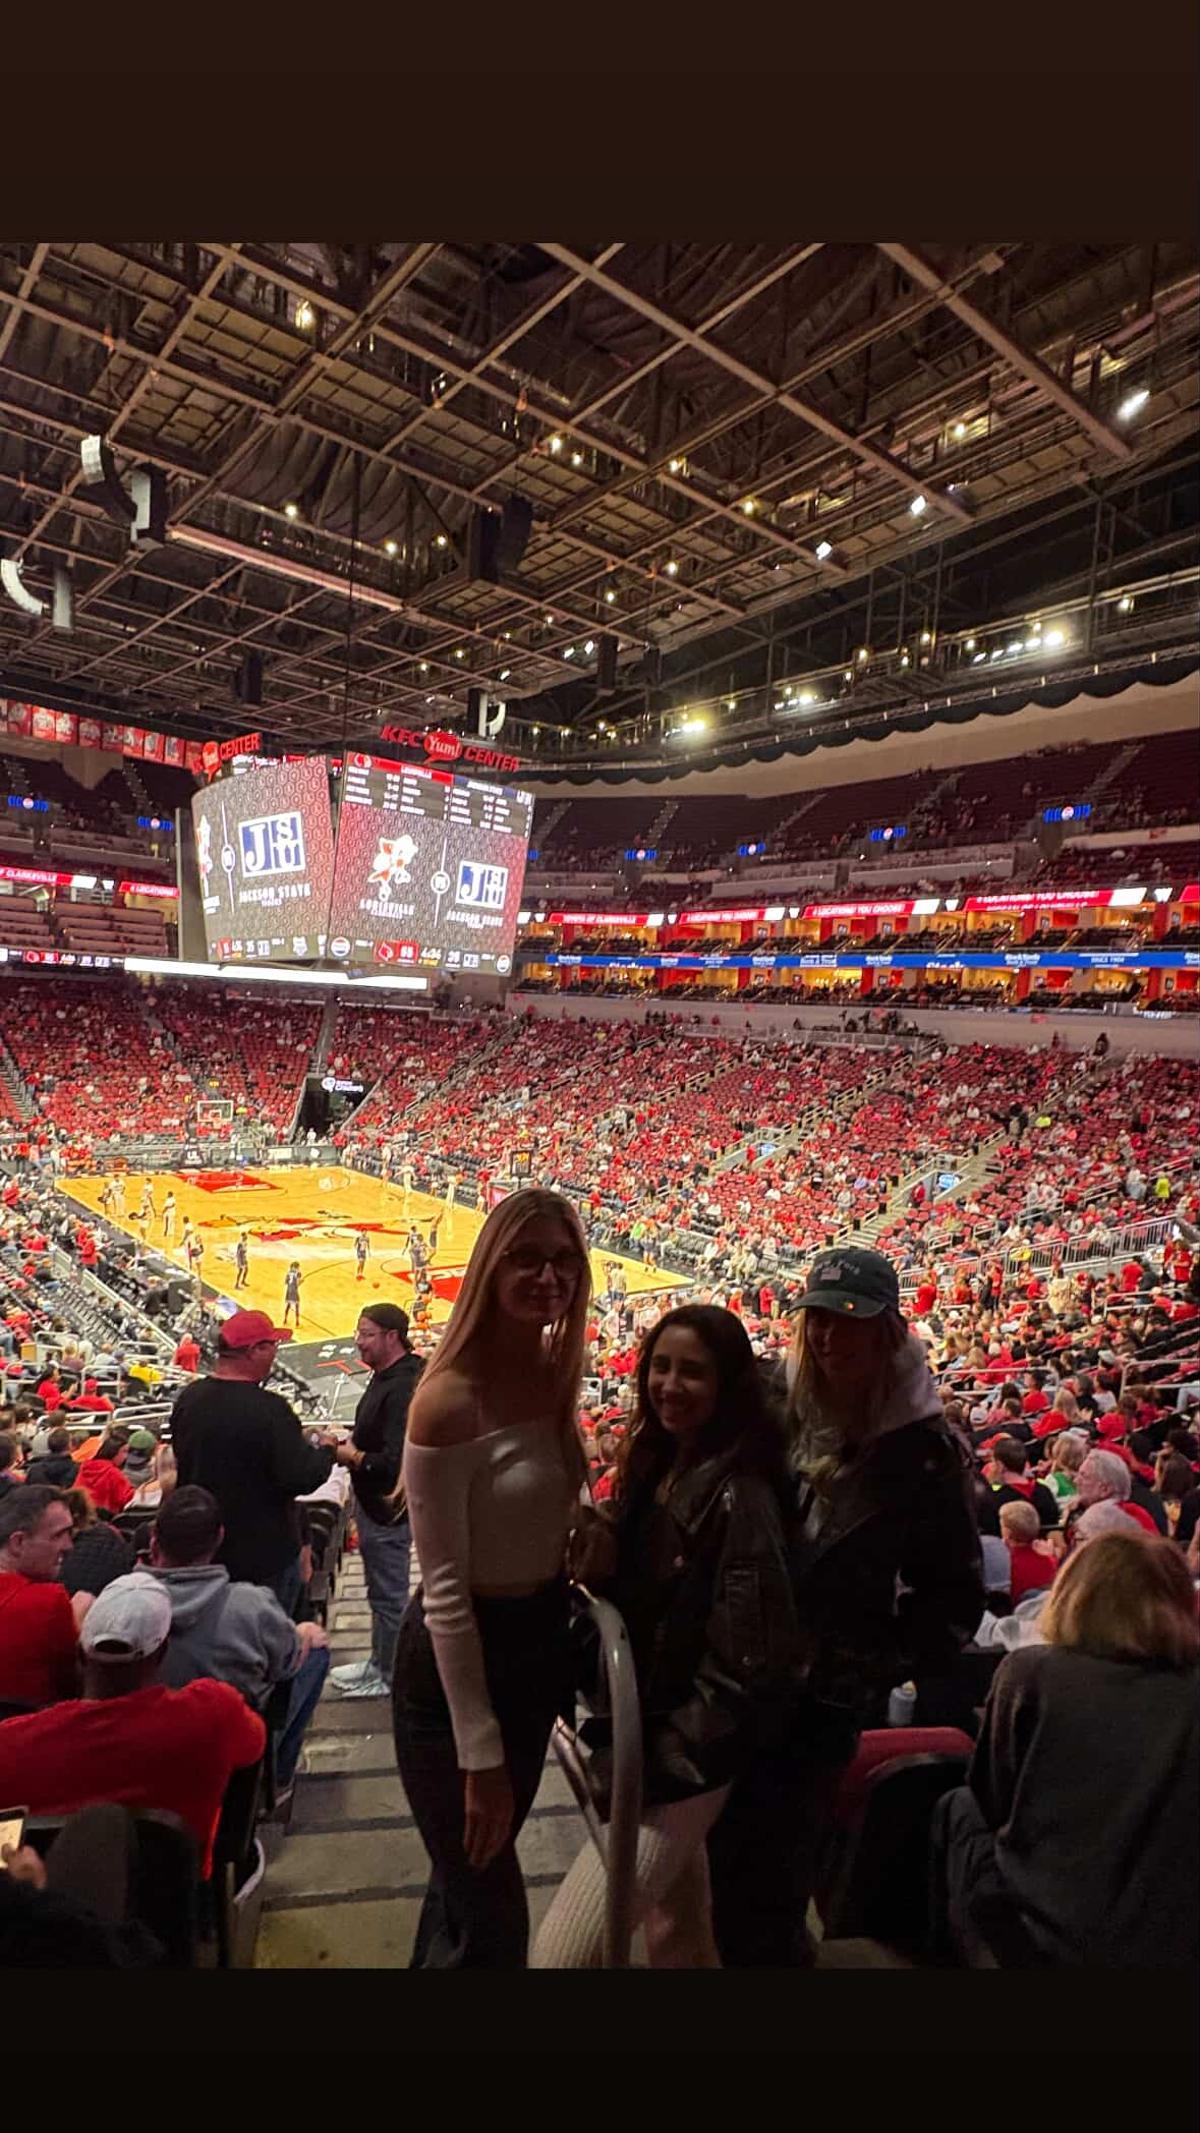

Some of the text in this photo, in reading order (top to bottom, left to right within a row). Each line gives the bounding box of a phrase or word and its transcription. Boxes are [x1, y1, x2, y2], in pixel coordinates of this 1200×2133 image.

[220, 732, 261, 760] CENTER
[380, 726, 520, 773] KFC Yum! CENTER
